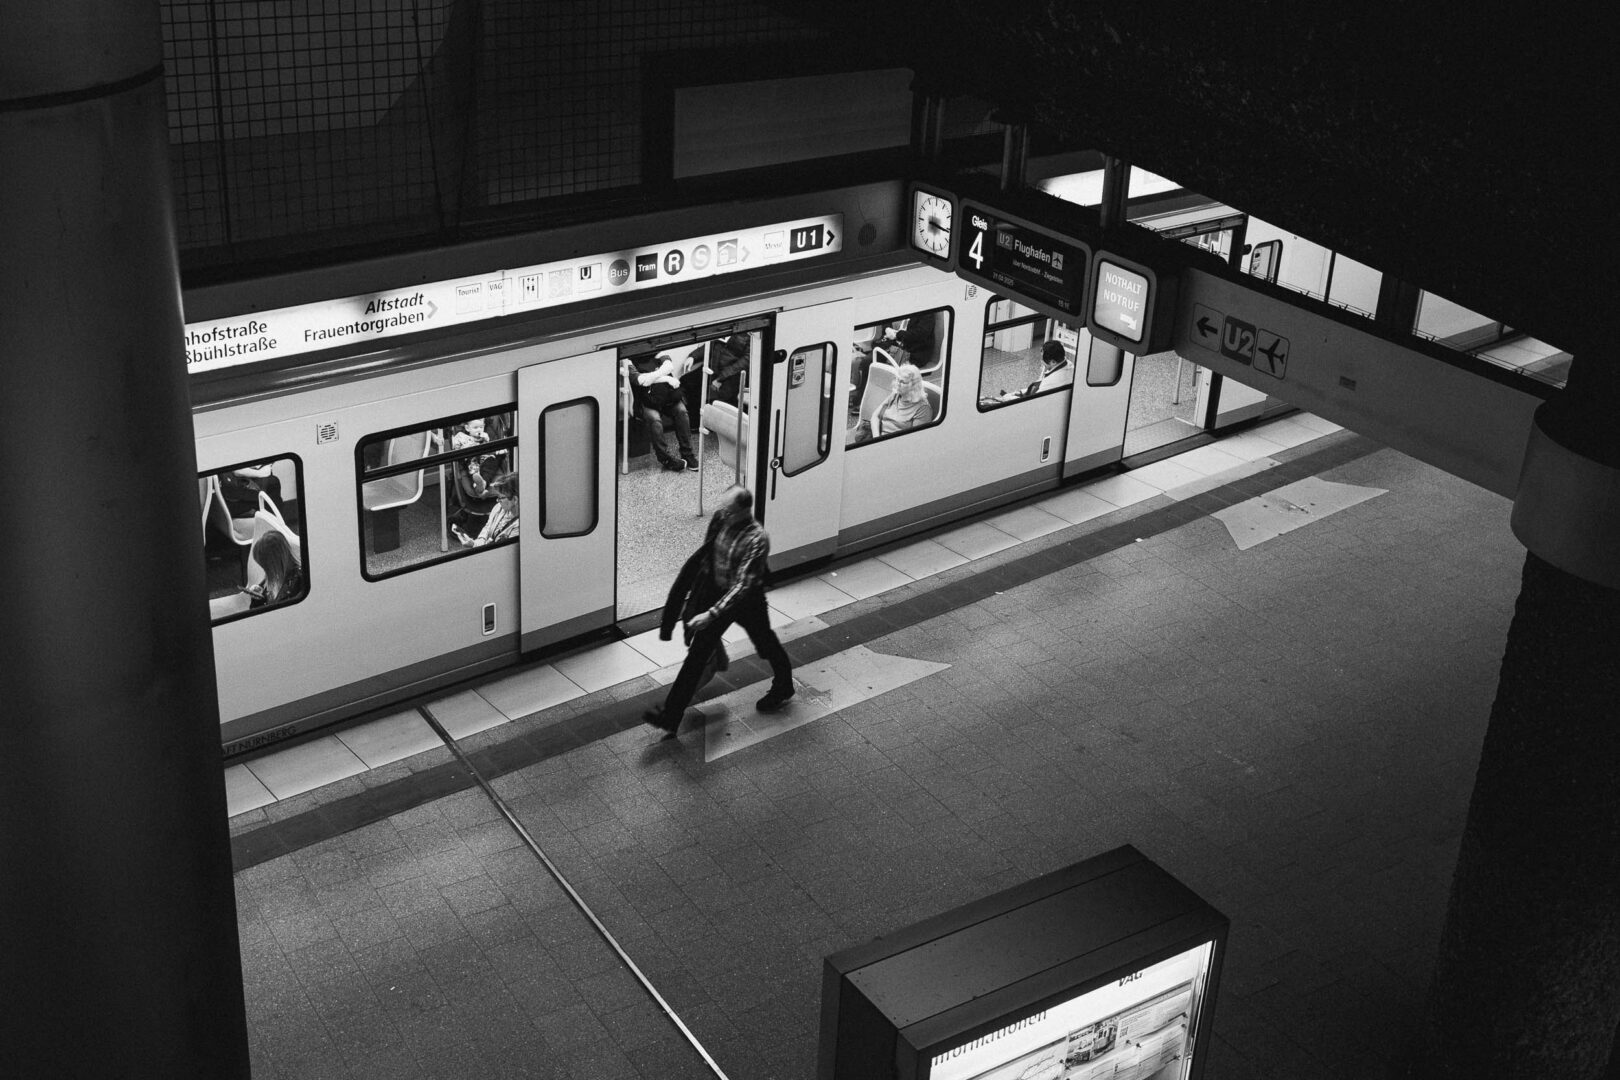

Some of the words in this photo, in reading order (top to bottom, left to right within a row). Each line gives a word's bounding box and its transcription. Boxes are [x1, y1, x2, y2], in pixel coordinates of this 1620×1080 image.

[971, 215, 988, 231] Gleis
[796, 230, 817, 247] U1
[968, 231, 984, 270] 4
[999, 233, 1010, 247] U2
[1014, 239, 1051, 264] Flughafen
[637, 261, 657, 273] Tram
[668, 254, 680, 271] R
[581, 267, 590, 279] U
[610, 267, 628, 278] Bus
[489, 282, 503, 291] VAG
[1105, 271, 1142, 295] NOTHALT
[458, 287, 480, 297] Tourist
[1103, 288, 1140, 312] NOTRUF
[365, 292, 425, 315] Altstadt
[303, 311, 425, 342] Frauentorgraben
[1224, 320, 1255, 358] U2
